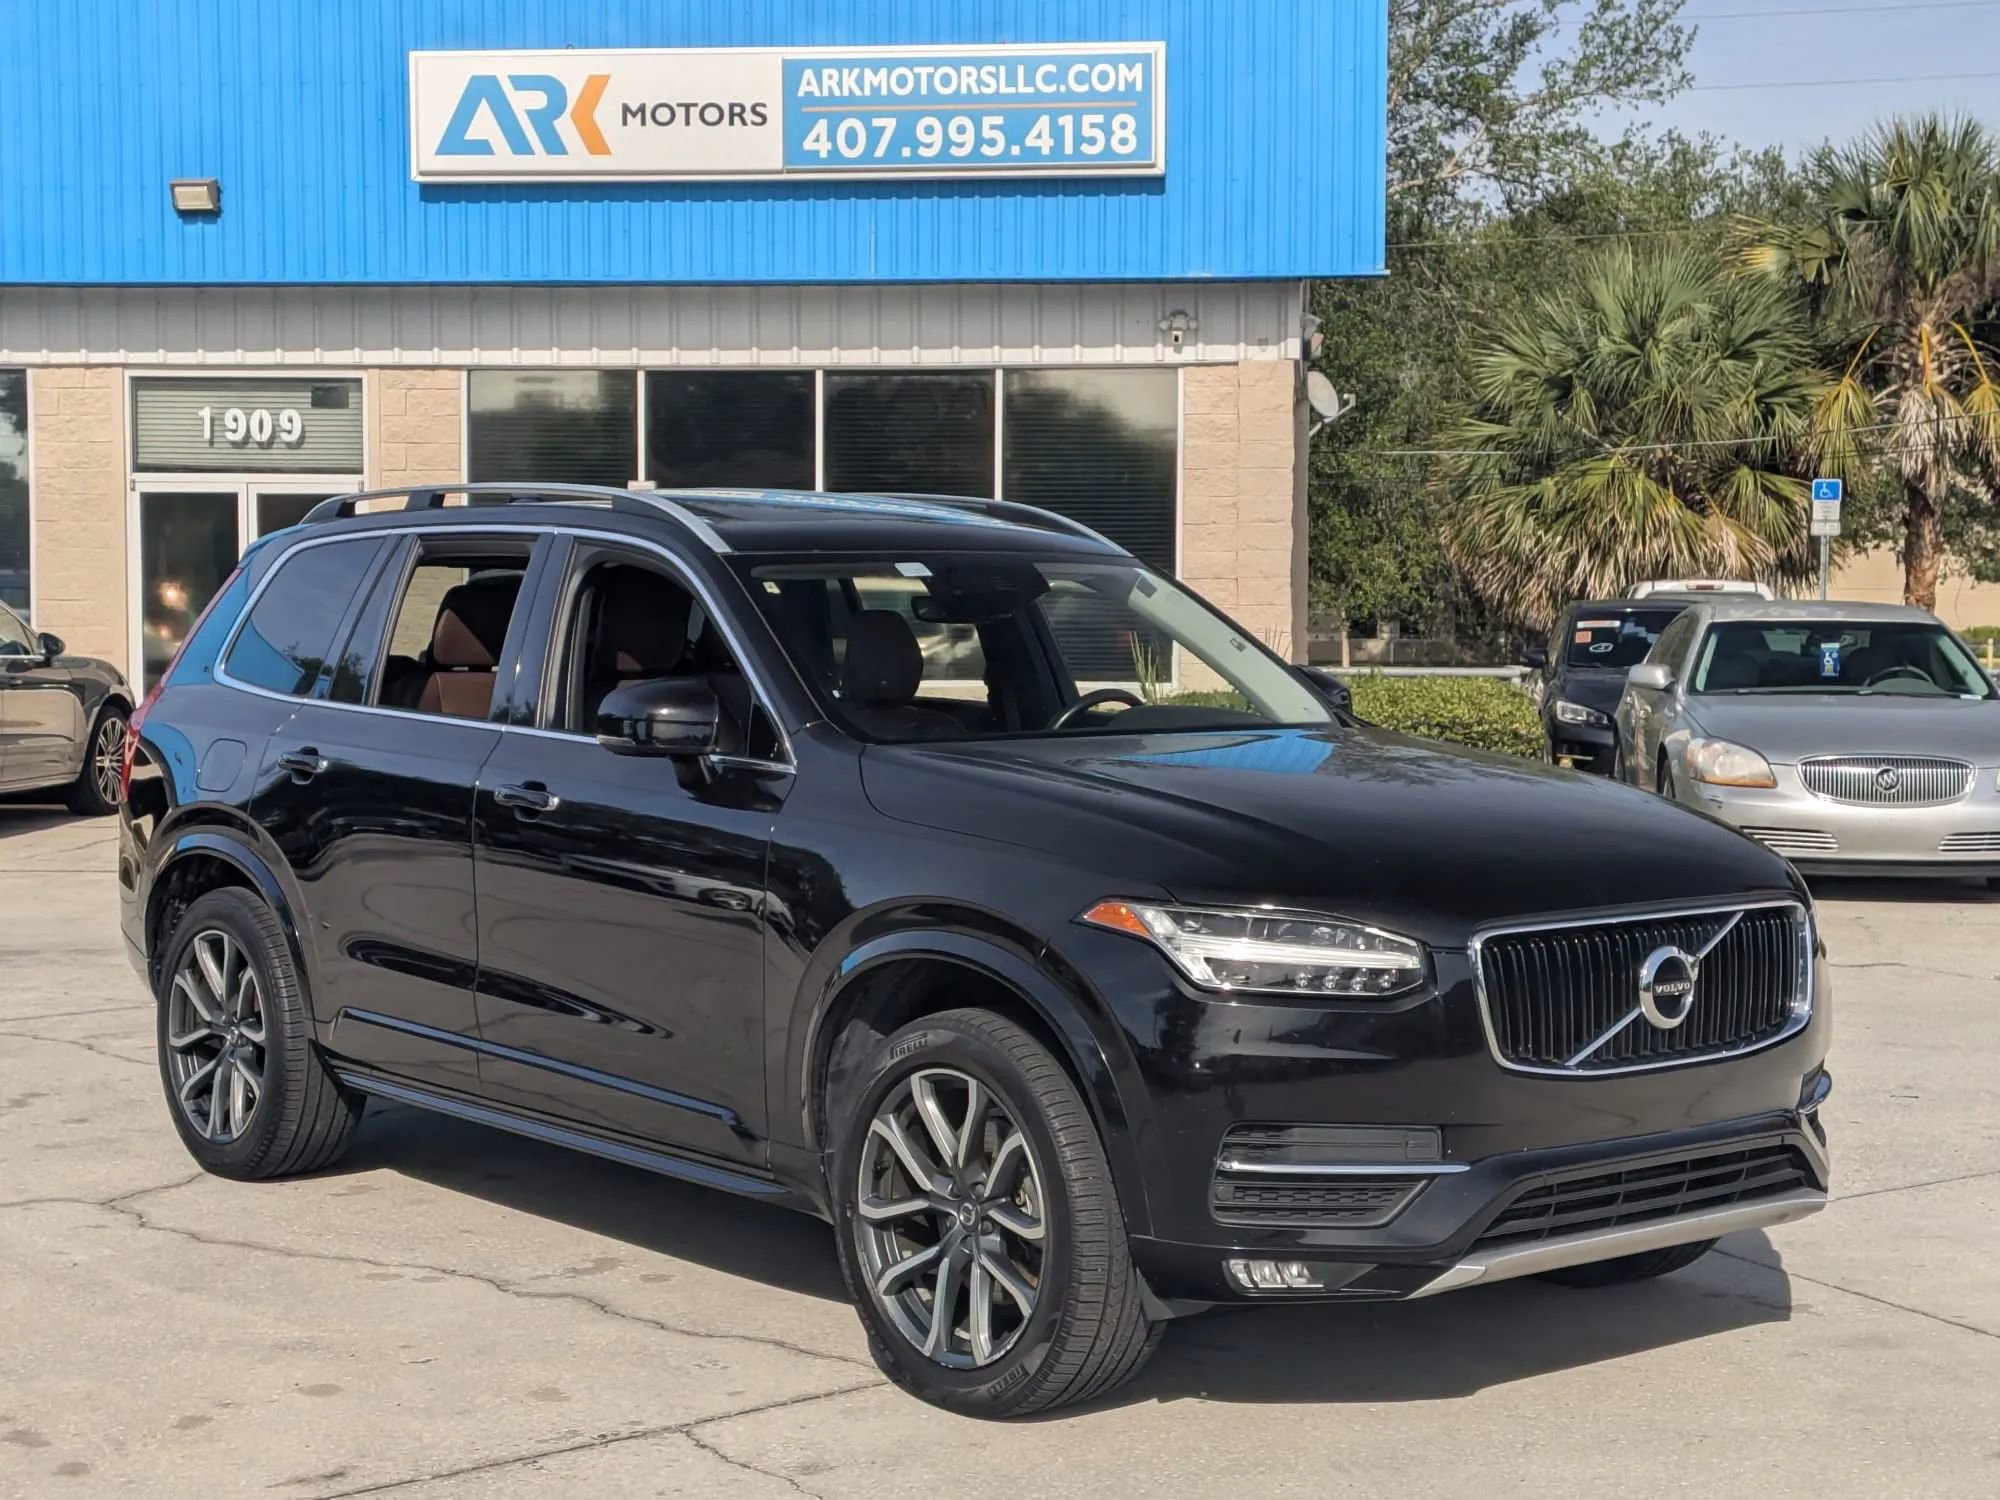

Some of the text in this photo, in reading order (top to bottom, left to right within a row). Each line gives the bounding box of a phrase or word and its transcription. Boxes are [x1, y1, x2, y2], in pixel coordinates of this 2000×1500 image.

[797, 62, 1143, 97] ARKMOTORSLLC.COM
[434, 74, 769, 156] ARK MOTORS
[802, 113, 1138, 159] 407.995.4158
[198, 406, 302, 442] 1909
[1655, 982, 1691, 993] VOLVO
[890, 1032, 928, 1061] PIRELLI
